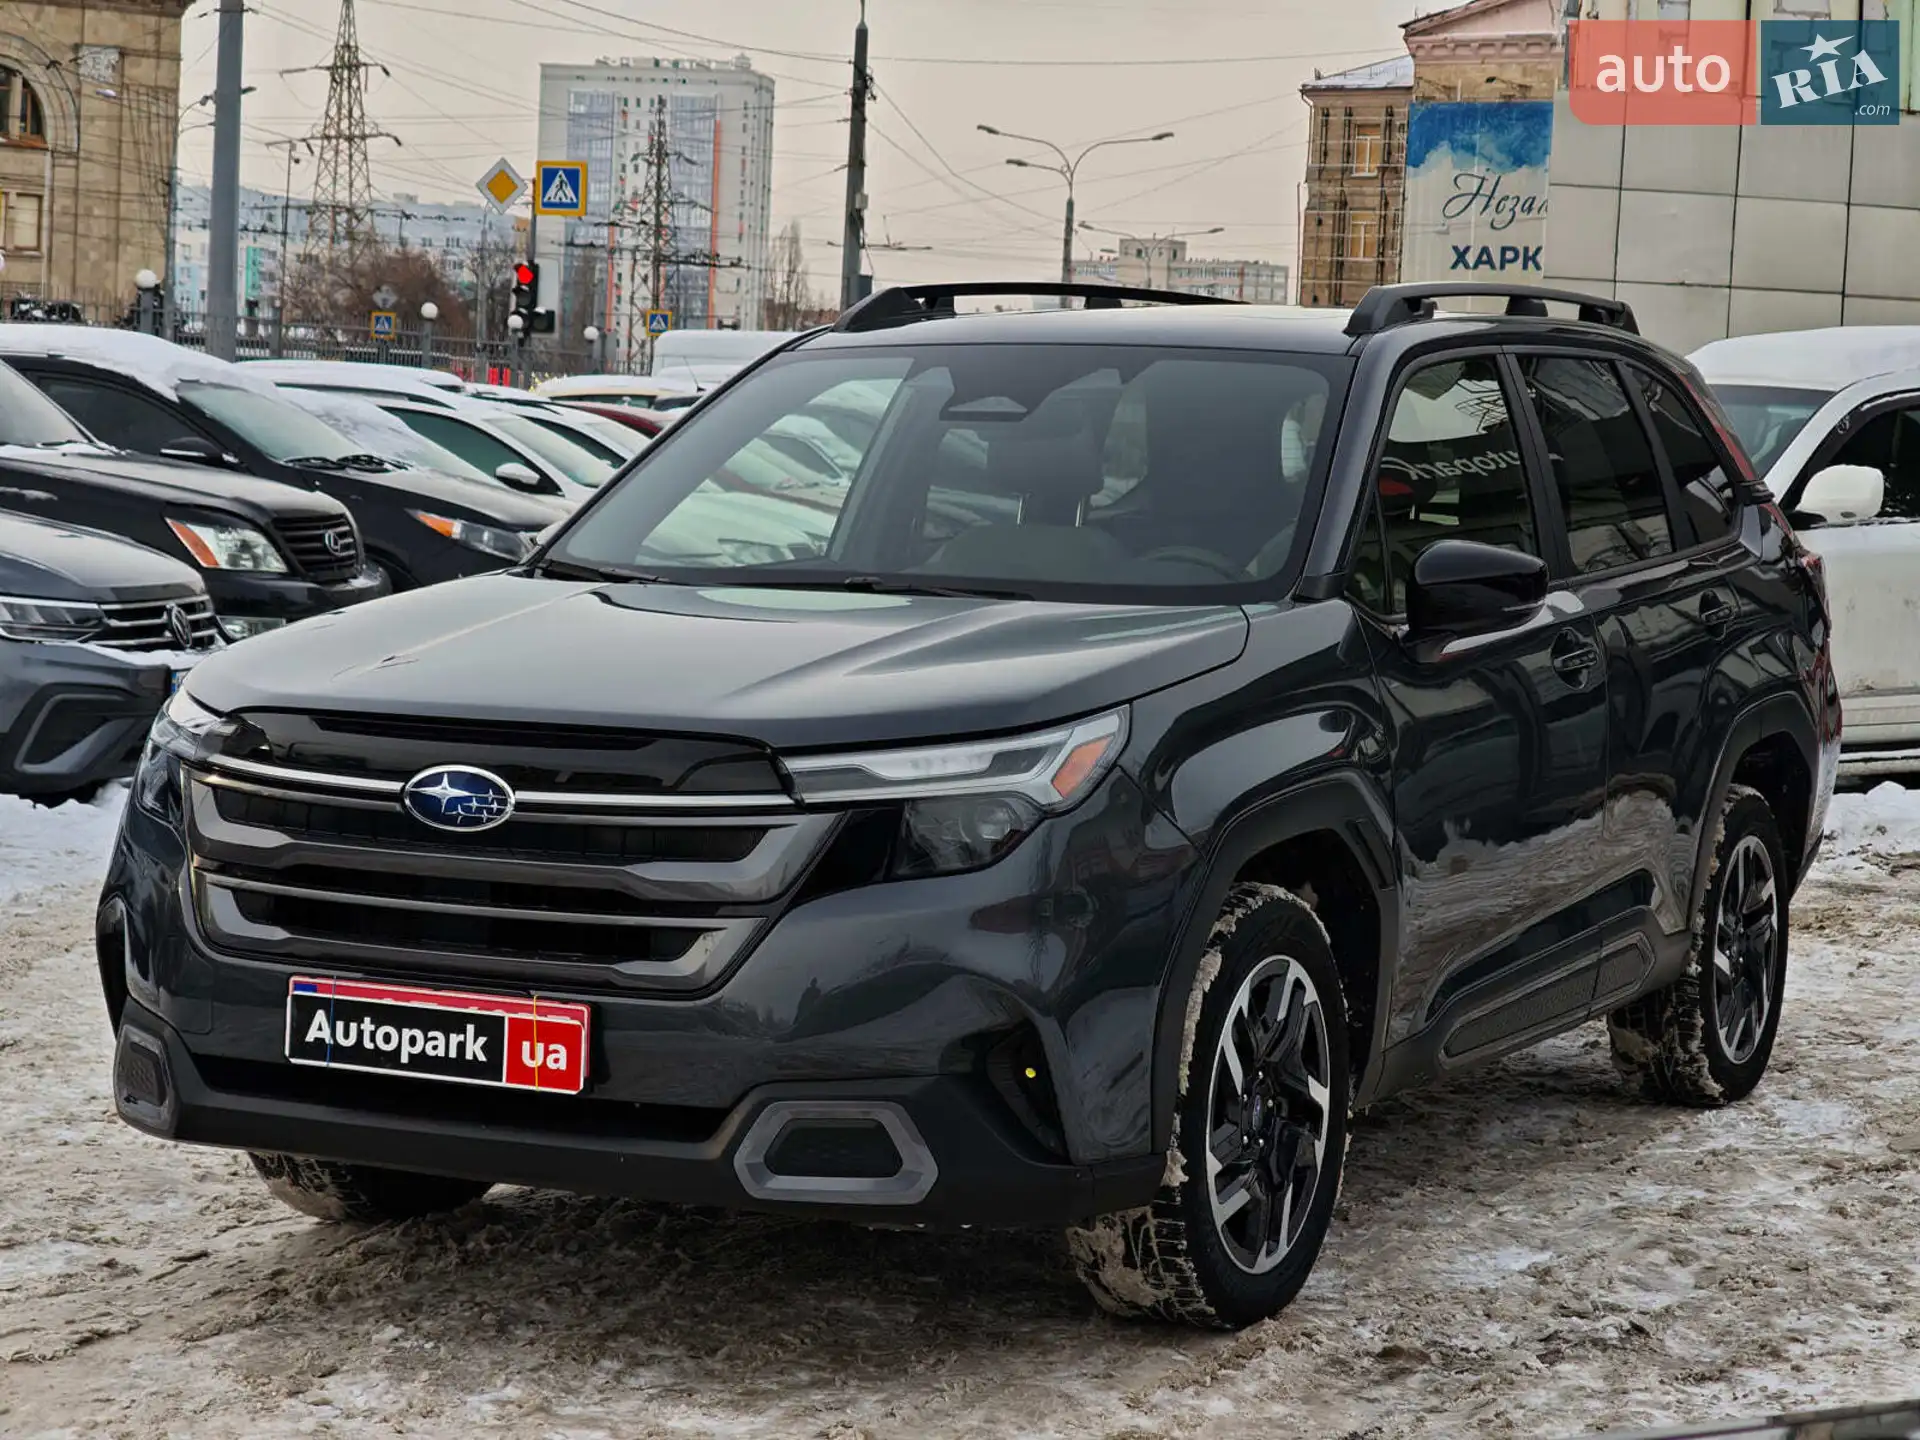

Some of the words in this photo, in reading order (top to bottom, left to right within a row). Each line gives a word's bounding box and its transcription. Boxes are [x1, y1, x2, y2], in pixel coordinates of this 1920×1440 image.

[1450, 245, 1544, 271] ХАРК
[304, 1008, 488, 1064] Autopark
[521, 1039, 567, 1071] ua
